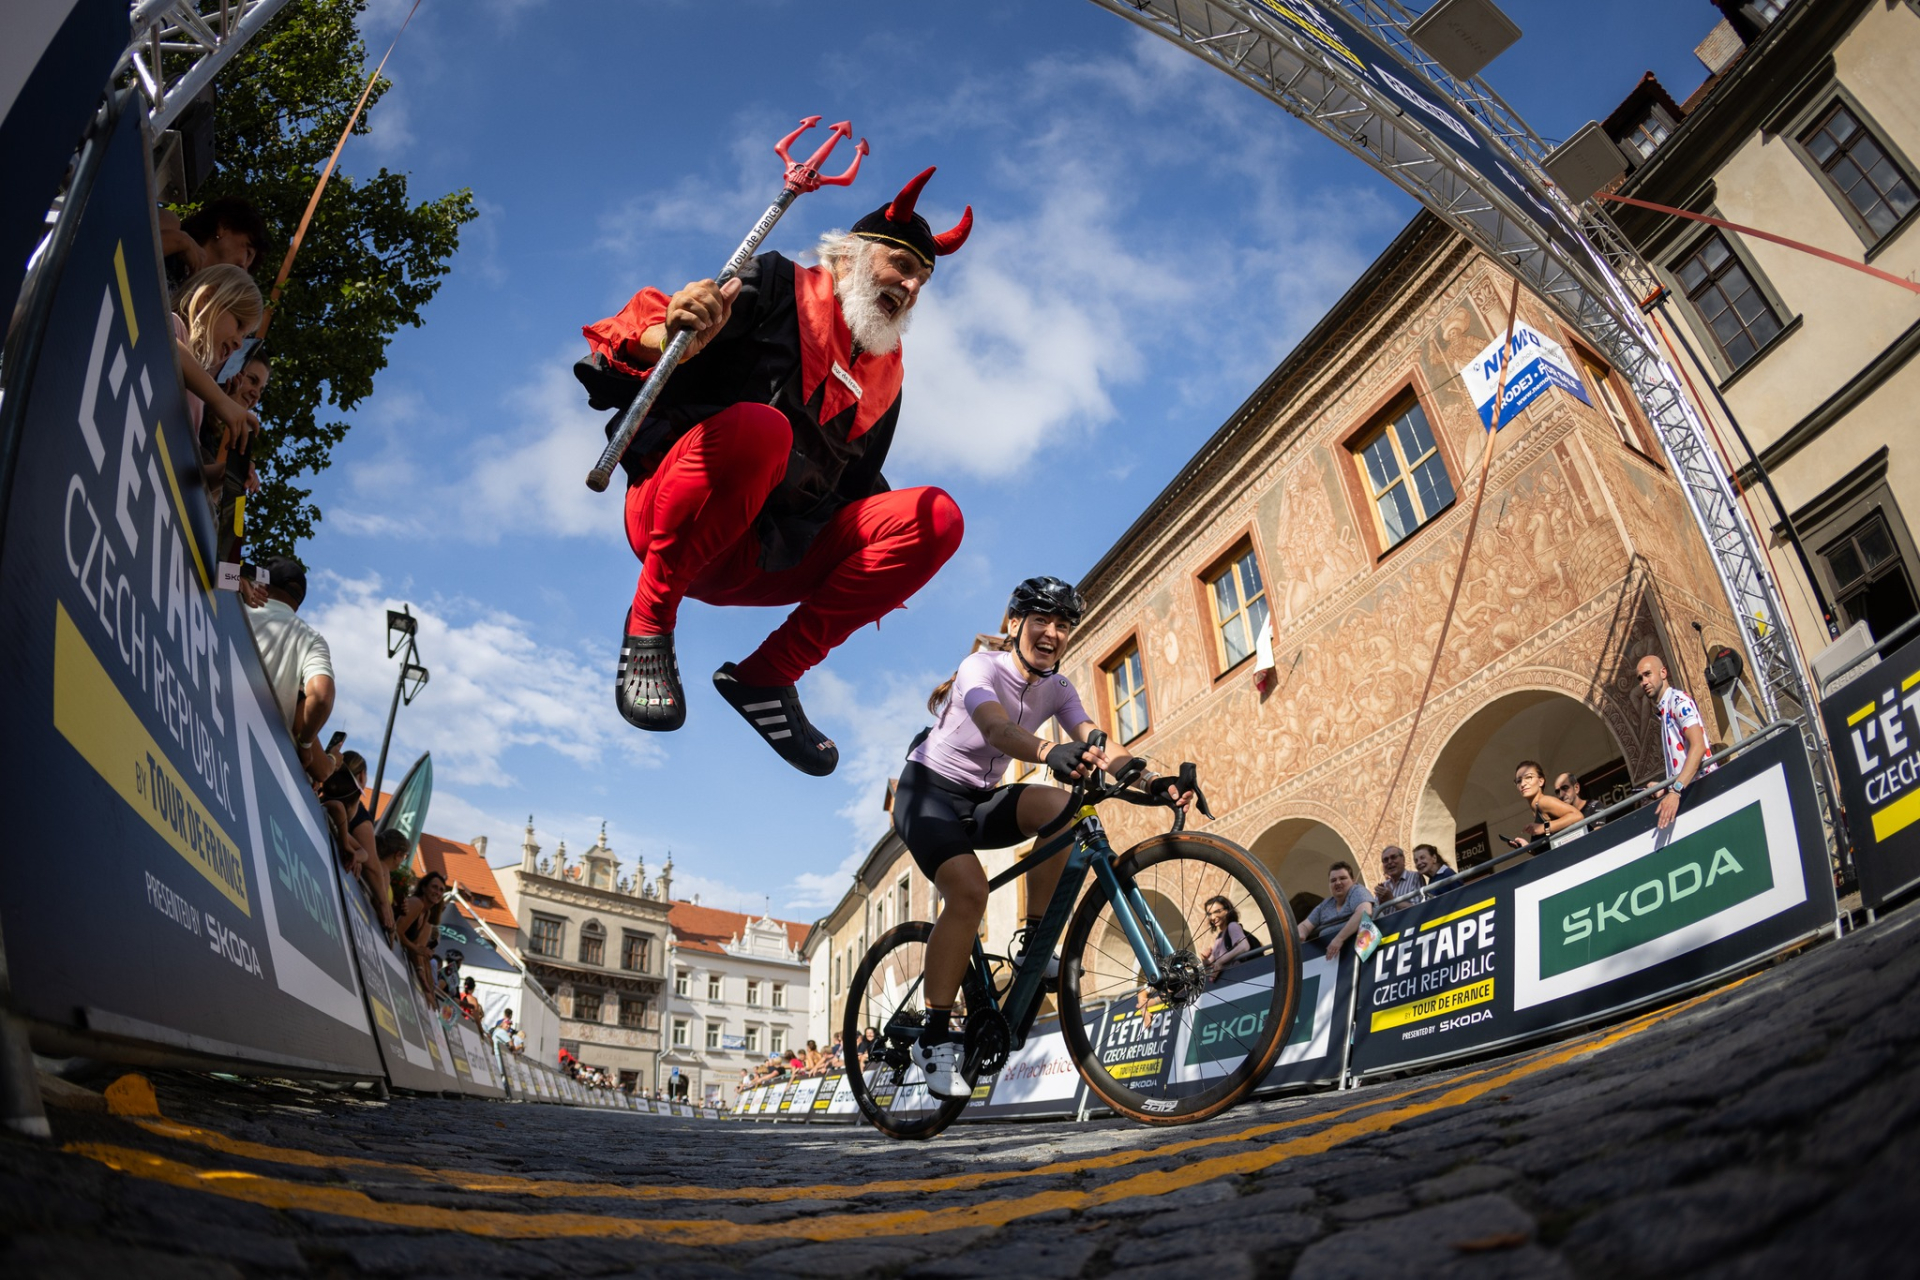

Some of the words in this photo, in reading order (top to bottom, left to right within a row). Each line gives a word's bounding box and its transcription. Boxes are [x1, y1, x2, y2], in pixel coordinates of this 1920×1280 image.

[728, 247, 749, 270] Tour
[746, 235, 759, 248] de
[754, 206, 780, 236] France
[77, 282, 225, 738] L'ÉTAPE
[64, 473, 147, 693] CZECH
[153, 635, 236, 822] REPUBLIC
[135, 760, 147, 800] BY
[146, 751, 188, 844] TOUR
[187, 801, 206, 861] DE
[203, 820, 245, 900] FRANCE
[145, 870, 192, 932] PRESENTED
[191, 907, 202, 938] BY
[1374, 909, 1496, 983] L'ÉTAPE
[1373, 977, 1416, 1006] CZECH
[1421, 951, 1495, 993] REPUBLIC
[1412, 1000, 1437, 1018] TOUR
[1438, 995, 1451, 1010] DE
[1452, 984, 1490, 1006] FRANCE
[1103, 1046, 1127, 1063] CZECH
[1126, 1040, 1167, 1060] REPUBLIC
[1106, 1010, 1173, 1047] L'ÉTAPE
[1402, 1027, 1428, 1040] PRESENTED
[1428, 1025, 1436, 1035] BY
[1016, 1056, 1074, 1079] Prachatice
